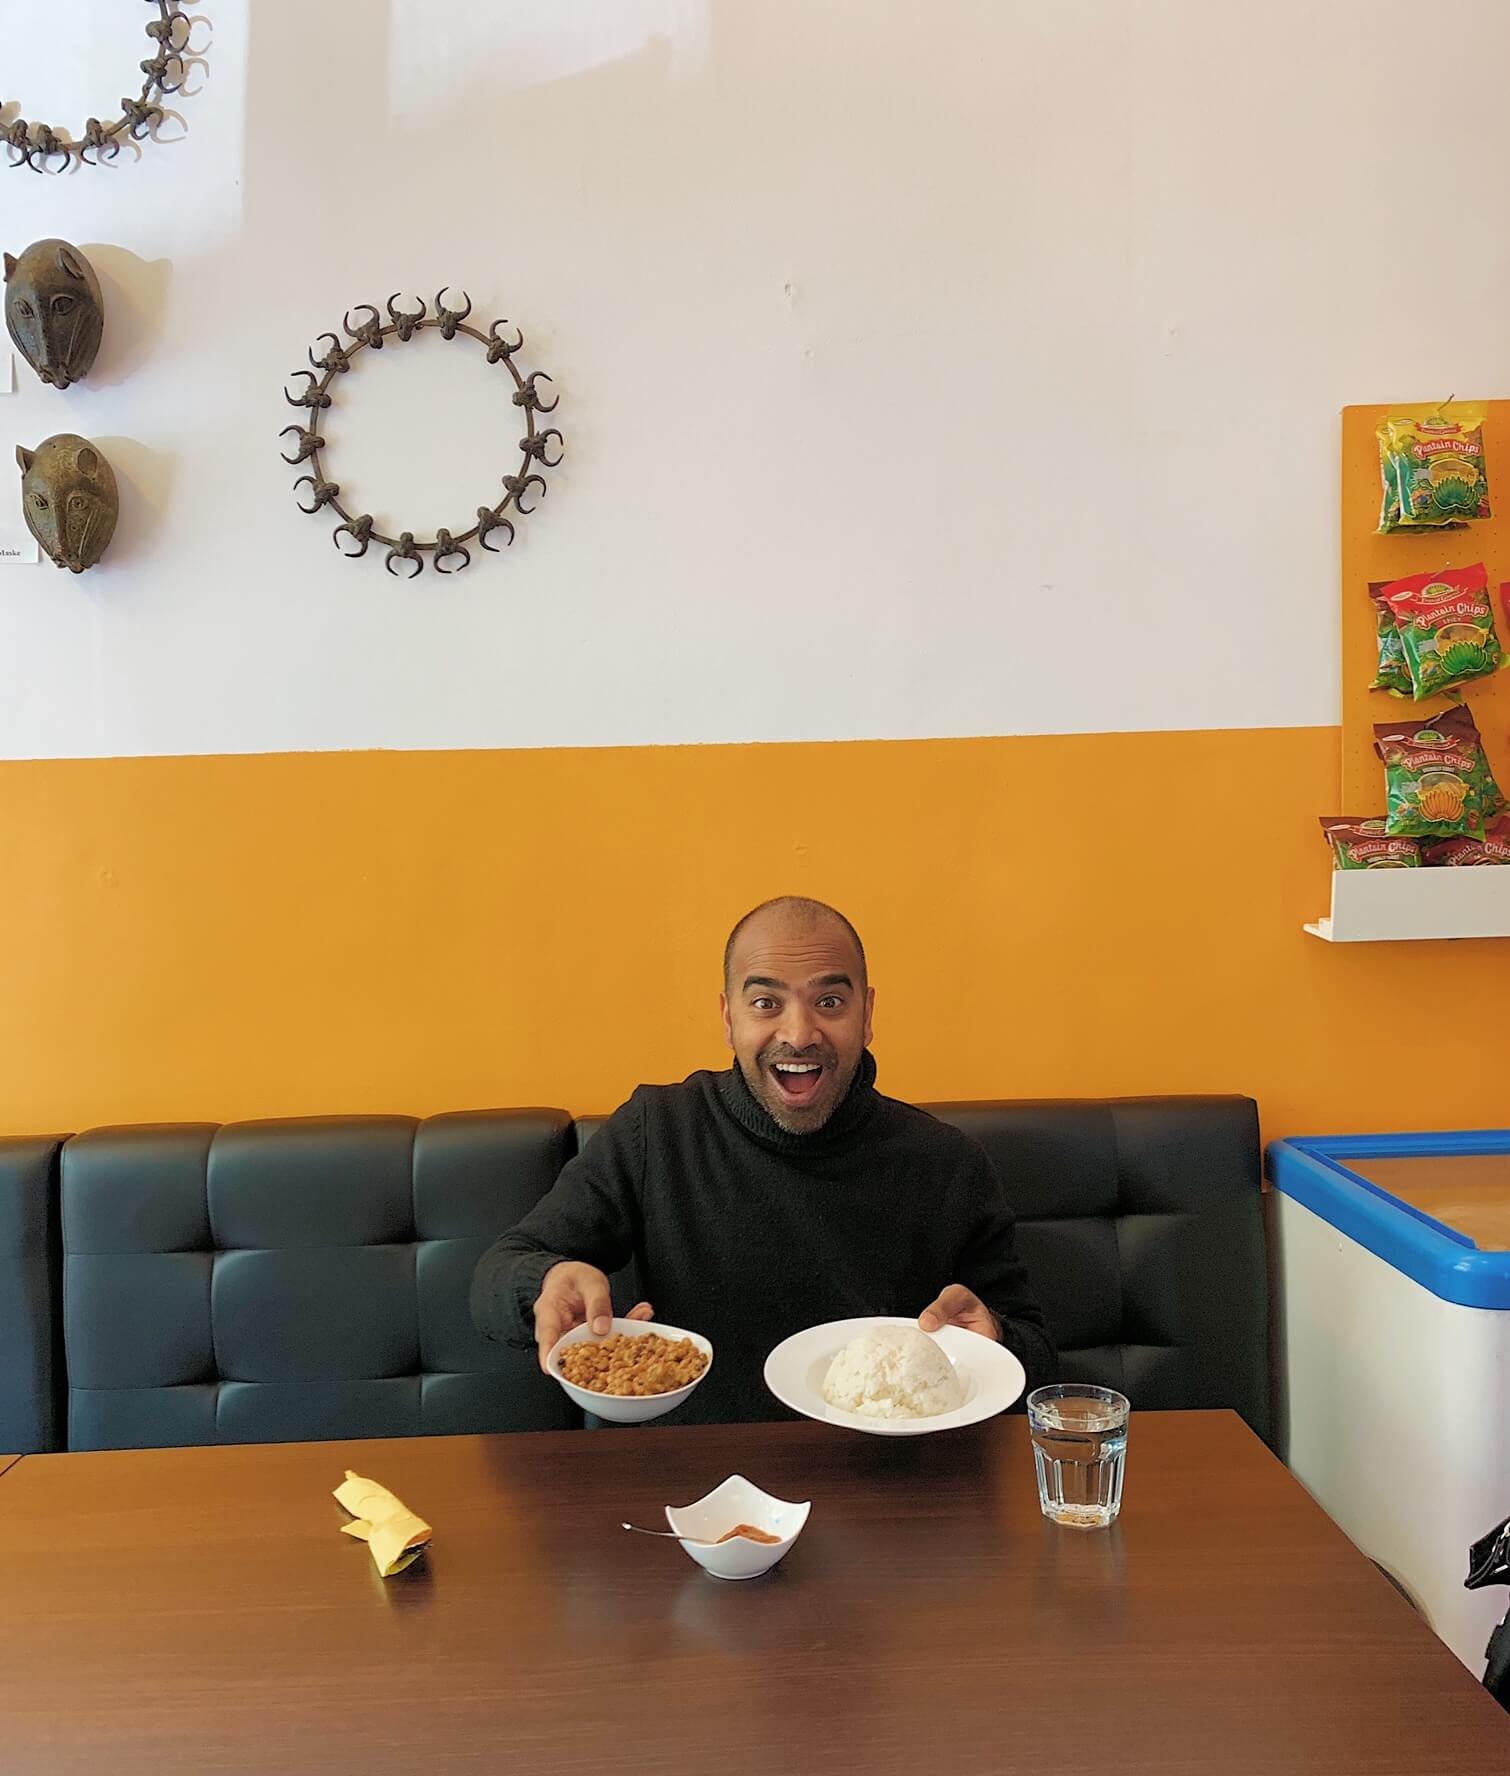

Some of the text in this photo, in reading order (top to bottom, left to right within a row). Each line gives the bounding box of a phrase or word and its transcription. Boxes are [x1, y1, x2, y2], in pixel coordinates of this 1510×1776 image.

[1452, 441, 1480, 453] Chips
[1415, 602, 1486, 627] Plantain Chips
[1403, 752, 1473, 769] Plantain Chips
[1350, 842, 1387, 861] Plantain
[1388, 841, 1416, 853] Chips
